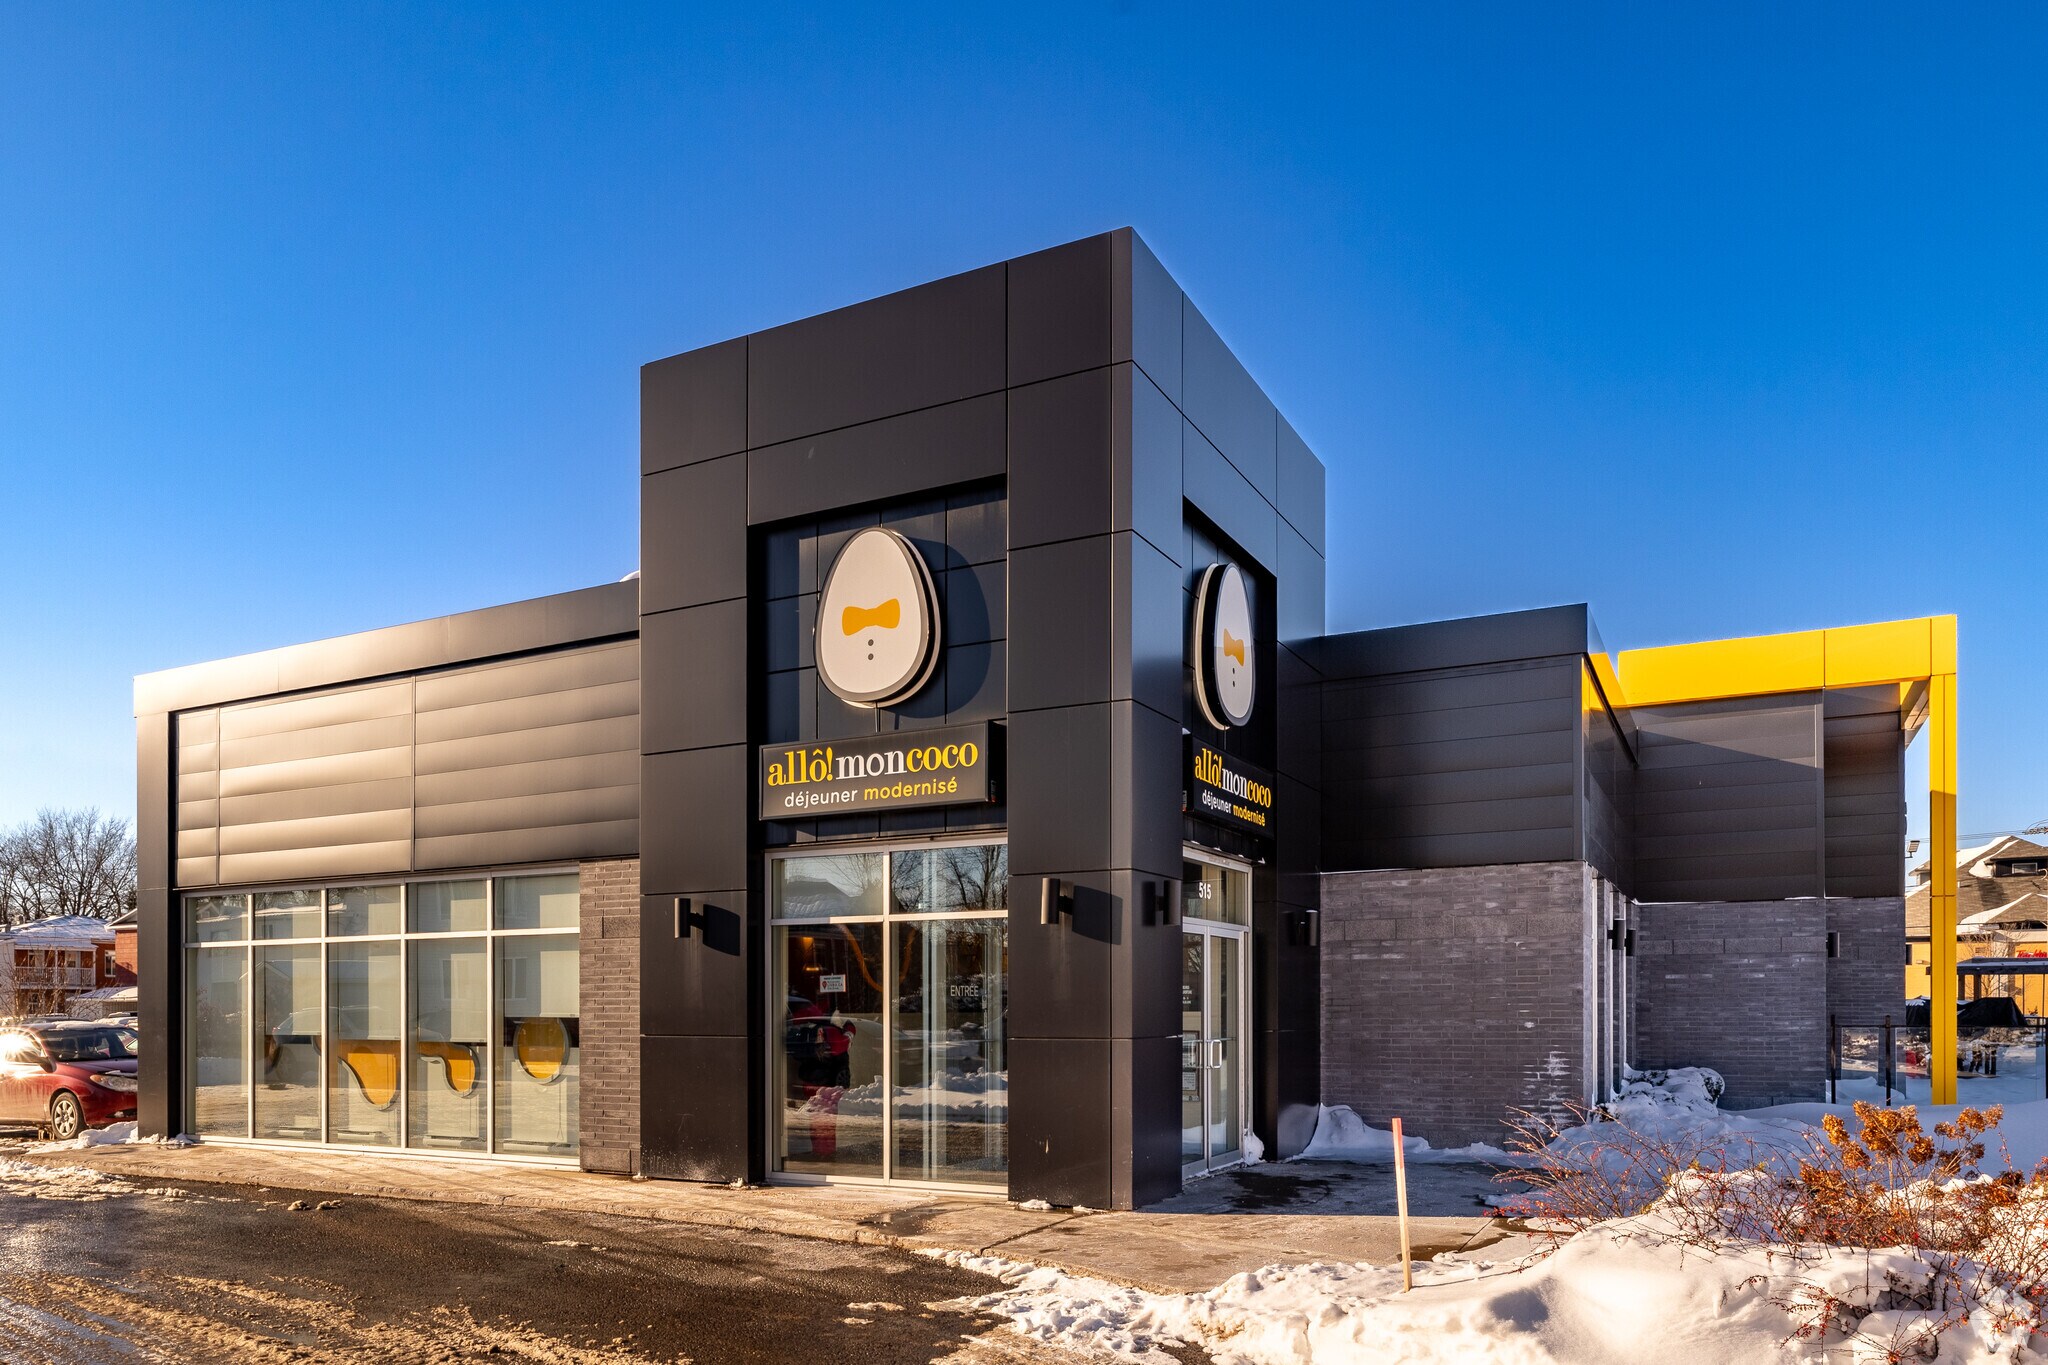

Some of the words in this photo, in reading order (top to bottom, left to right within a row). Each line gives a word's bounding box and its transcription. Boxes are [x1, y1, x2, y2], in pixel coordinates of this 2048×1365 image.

[784, 788, 858, 809] déjeuner
[863, 776, 958, 801] modernisé
[1201, 789, 1232, 815] déjeuner
[1232, 803, 1266, 827] modernisé
[1198, 881, 1212, 900] 515
